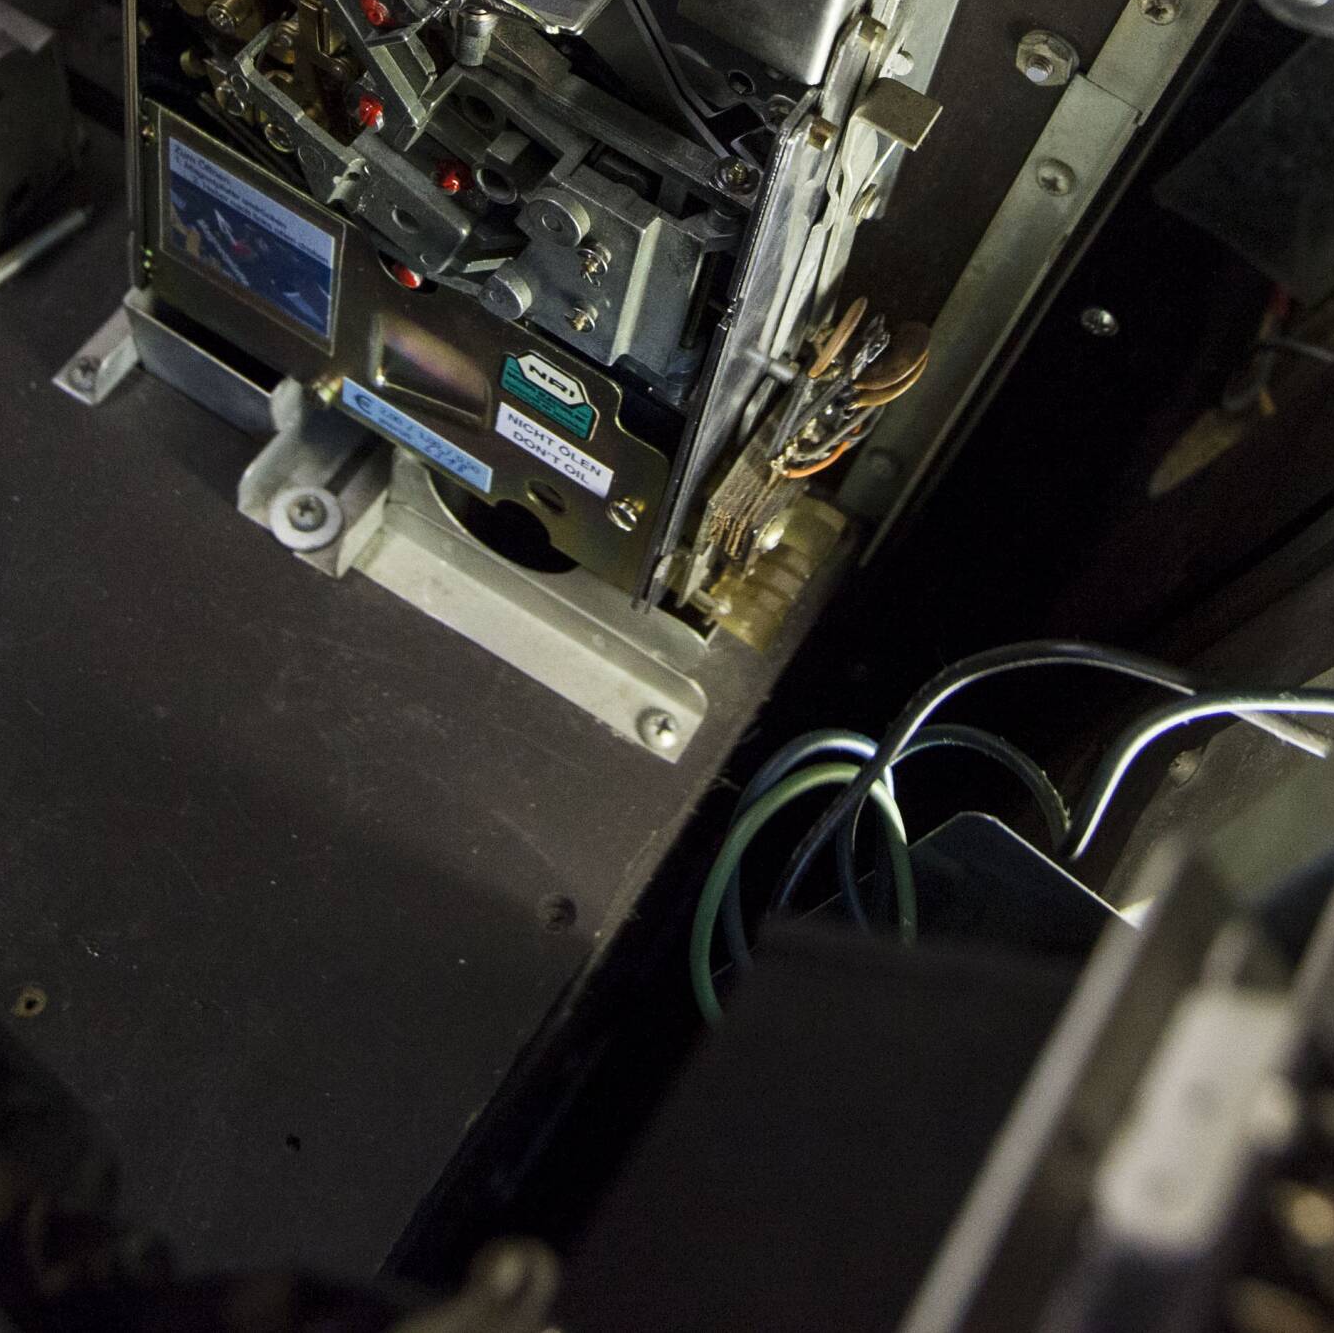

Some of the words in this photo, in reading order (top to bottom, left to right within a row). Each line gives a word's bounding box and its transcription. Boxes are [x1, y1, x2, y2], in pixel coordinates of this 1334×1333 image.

[508, 413, 555, 446] NICHT
[513, 431, 560, 464] DON'T
[564, 463, 589, 485] OIL
